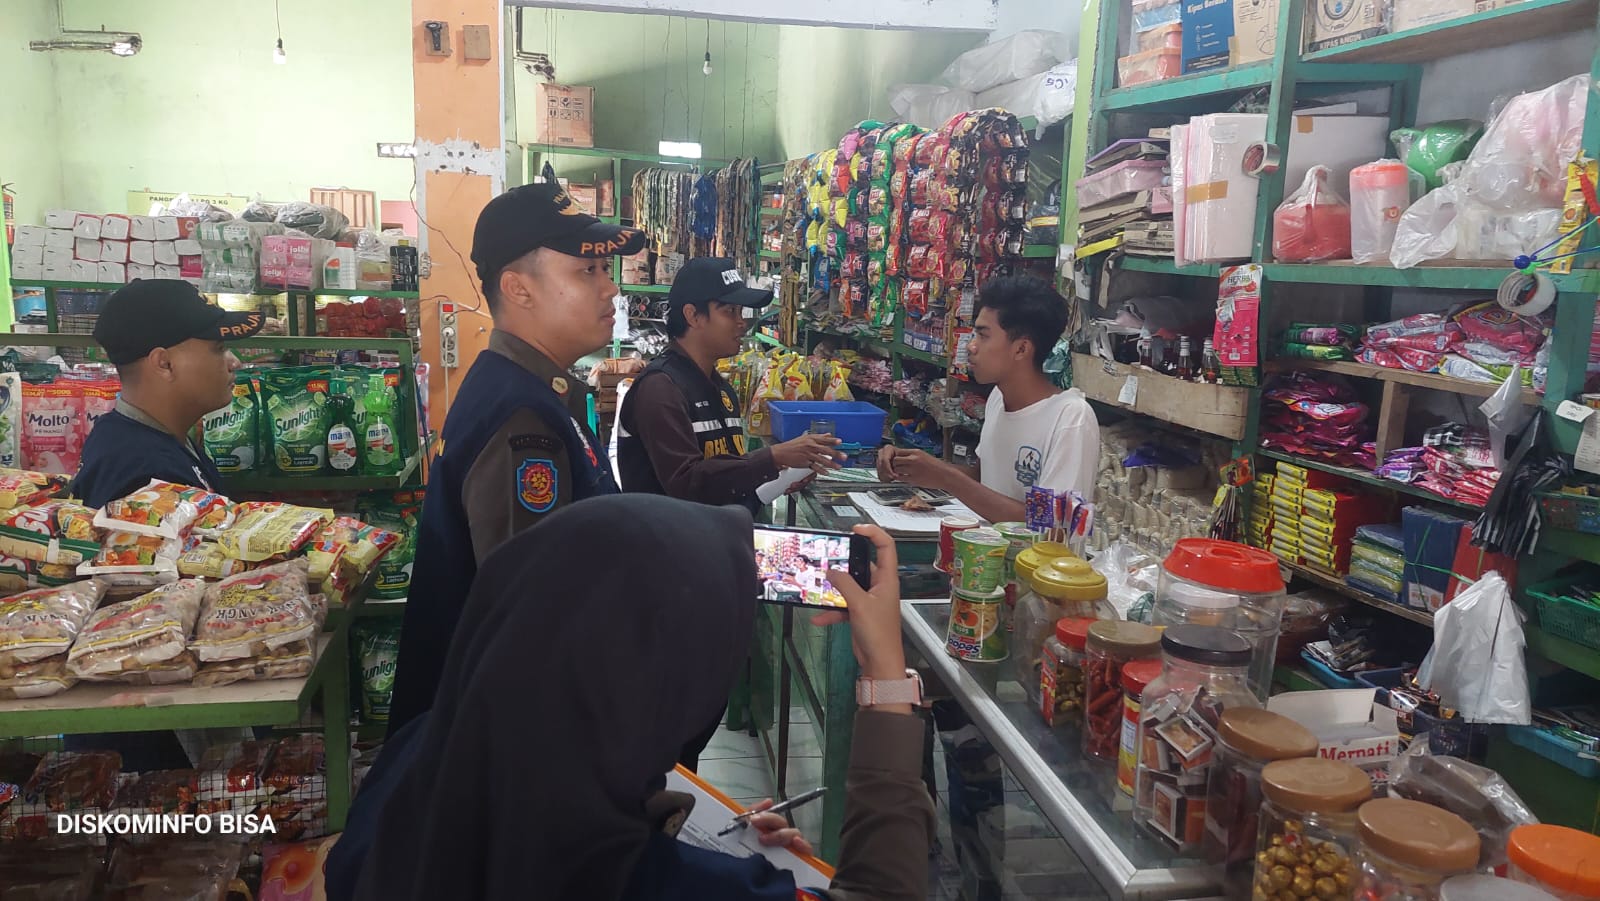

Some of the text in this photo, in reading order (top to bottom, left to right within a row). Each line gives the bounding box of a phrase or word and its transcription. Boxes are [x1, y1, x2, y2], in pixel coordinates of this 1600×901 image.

[580, 230, 636, 255] PRAJA
[28, 412, 70, 427] Molto
[203, 410, 245, 433] unlight
[275, 407, 321, 437] Sunlight
